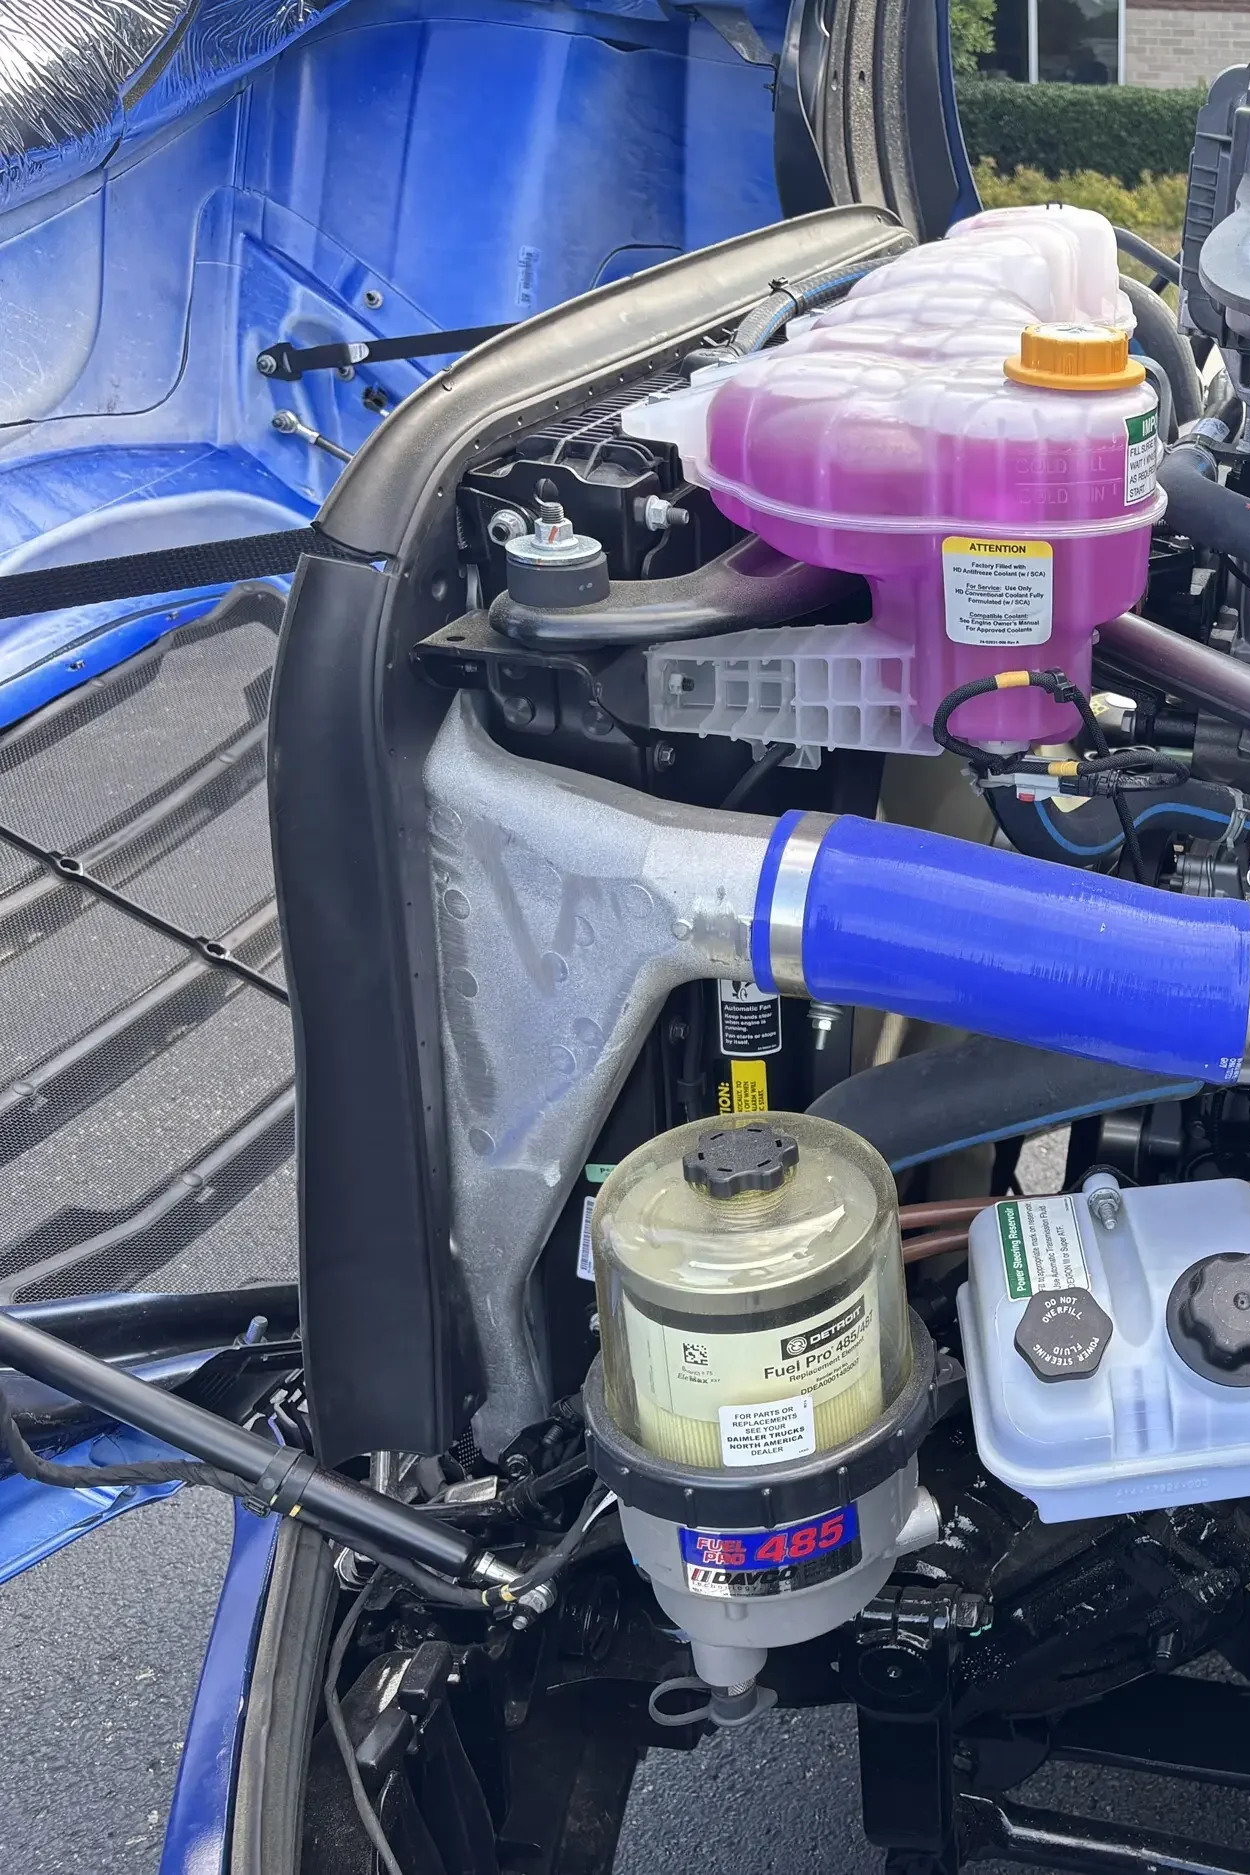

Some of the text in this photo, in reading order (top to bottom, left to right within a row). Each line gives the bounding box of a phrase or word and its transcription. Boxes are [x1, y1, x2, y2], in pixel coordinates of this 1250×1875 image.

[1130, 447, 1140, 458] FILL
[970, 543, 1026, 553] ATTENTION
[972, 562, 994, 570] Factory
[965, 590, 1004, 598] Conventional
[1039, 1206, 1048, 1218] Fluid
[1031, 1233, 1039, 1247] mark
[1043, 1219, 1054, 1252] Transmission
[1005, 1207, 1026, 1292] Power Steering Reservoir
[1060, 1238, 1069, 1252] Super
[1033, 1248, 1044, 1276] appropriate
[1049, 1252, 1060, 1278] Automatic
[1045, 1297, 1077, 1309] DO NOT
[1042, 1306, 1082, 1323] OVERFILL
[810, 1305, 862, 1345] DETROIT
[1033, 1337, 1100, 1366] POWER STEERING
[1053, 1343, 1083, 1355] FLUID
[764, 1364, 801, 1380] Fuel
[806, 1350, 832, 1369] Pro
[789, 1336, 865, 1383] Replacement Element
[753, 1410, 780, 1418] PARTS
[782, 1406, 794, 1414] OR
[732, 1413, 798, 1427] REPLACEMENTS
[763, 1423, 786, 1432] YOUR
[769, 1426, 805, 1439] TRUCKS
[764, 1434, 804, 1447] AMERICA
[751, 1446, 784, 1456] DEALER
[697, 1514, 845, 1563] FUEL 485
[703, 1550, 746, 1565] PRO
[712, 1566, 798, 1586] DAVCO
